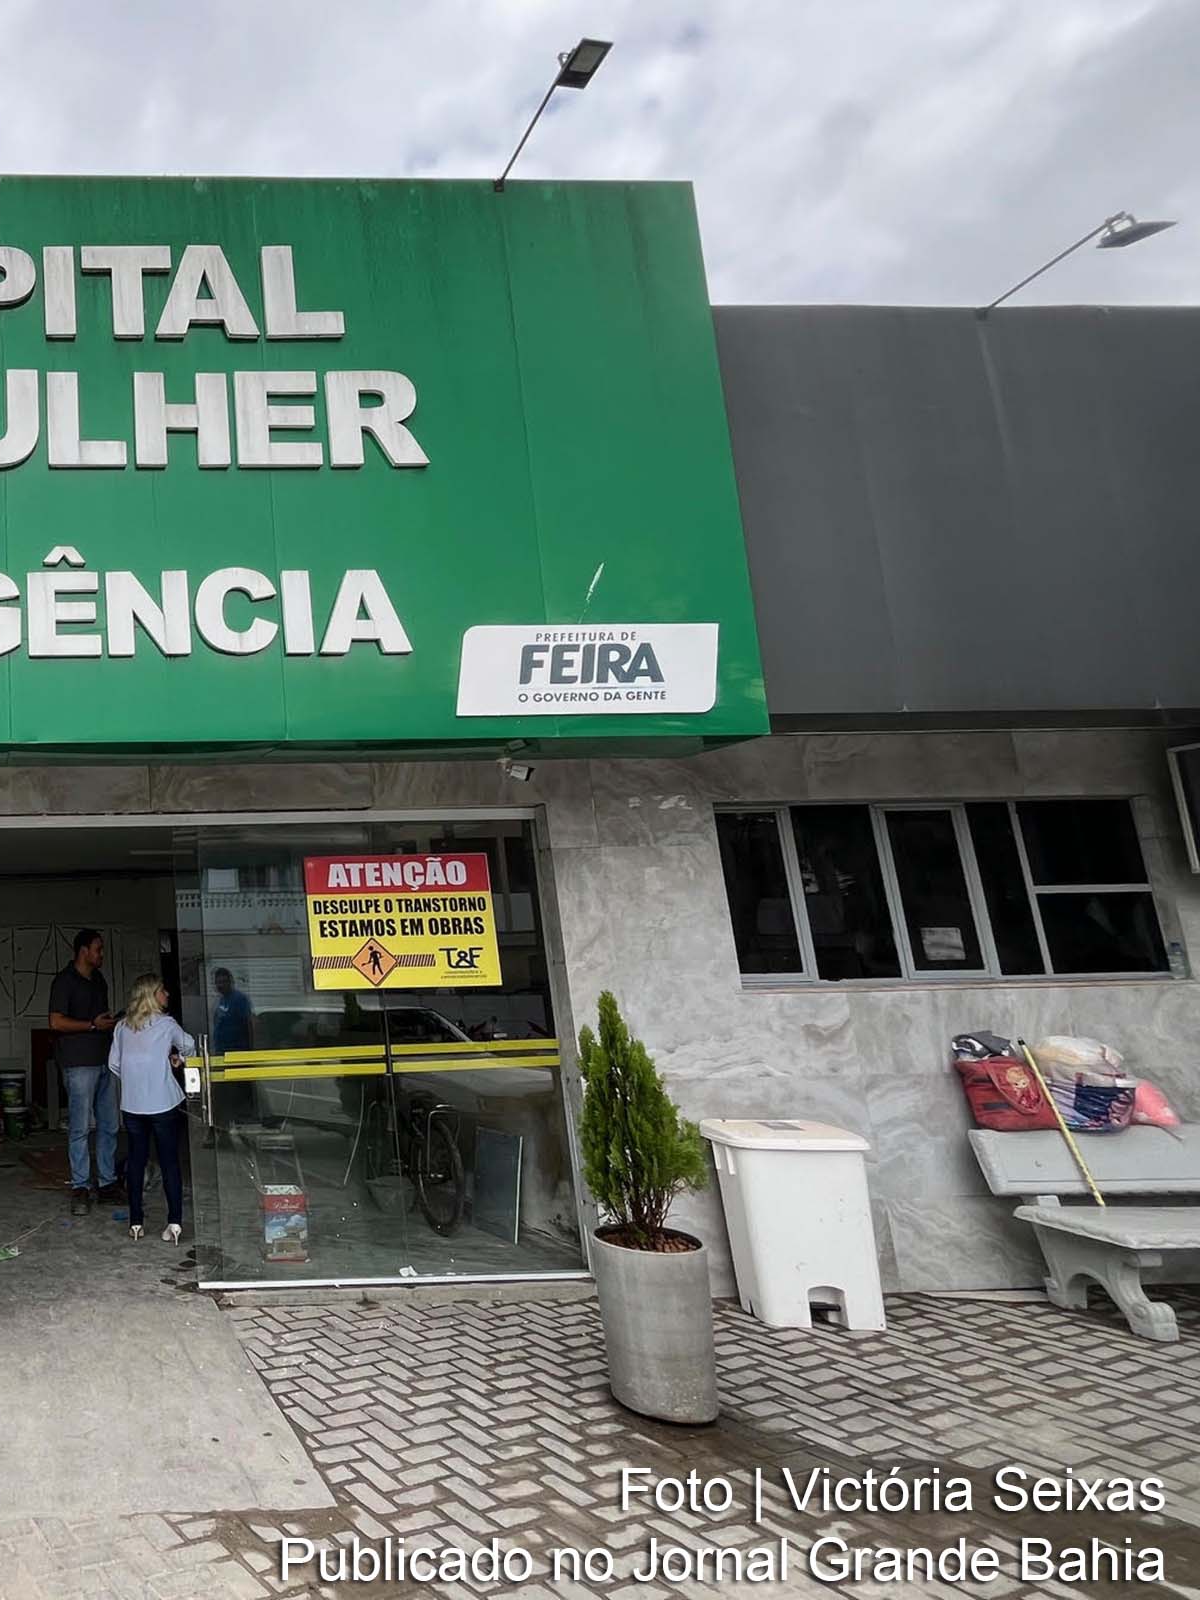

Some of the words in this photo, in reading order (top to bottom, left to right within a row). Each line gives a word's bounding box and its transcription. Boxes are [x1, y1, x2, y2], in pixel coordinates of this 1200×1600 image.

[535, 632, 615, 643] PREFEITURA
[620, 631, 637, 642] DE
[519, 642, 665, 685] FEIRA
[518, 693, 528, 703] O
[532, 692, 600, 702] GOVERNO
[603, 691, 623, 701] DA
[625, 690, 667, 701] GENTE
[327, 856, 468, 891] ATENÇÃO
[313, 899, 381, 915] DESCULPE
[384, 898, 394, 914] O
[397, 896, 487, 913] TRANSTORNO
[319, 918, 397, 938] ESTAMOS
[400, 917, 424, 936] EM
[428, 916, 485, 935] OBRAS
[438, 947, 484, 969] T&F
